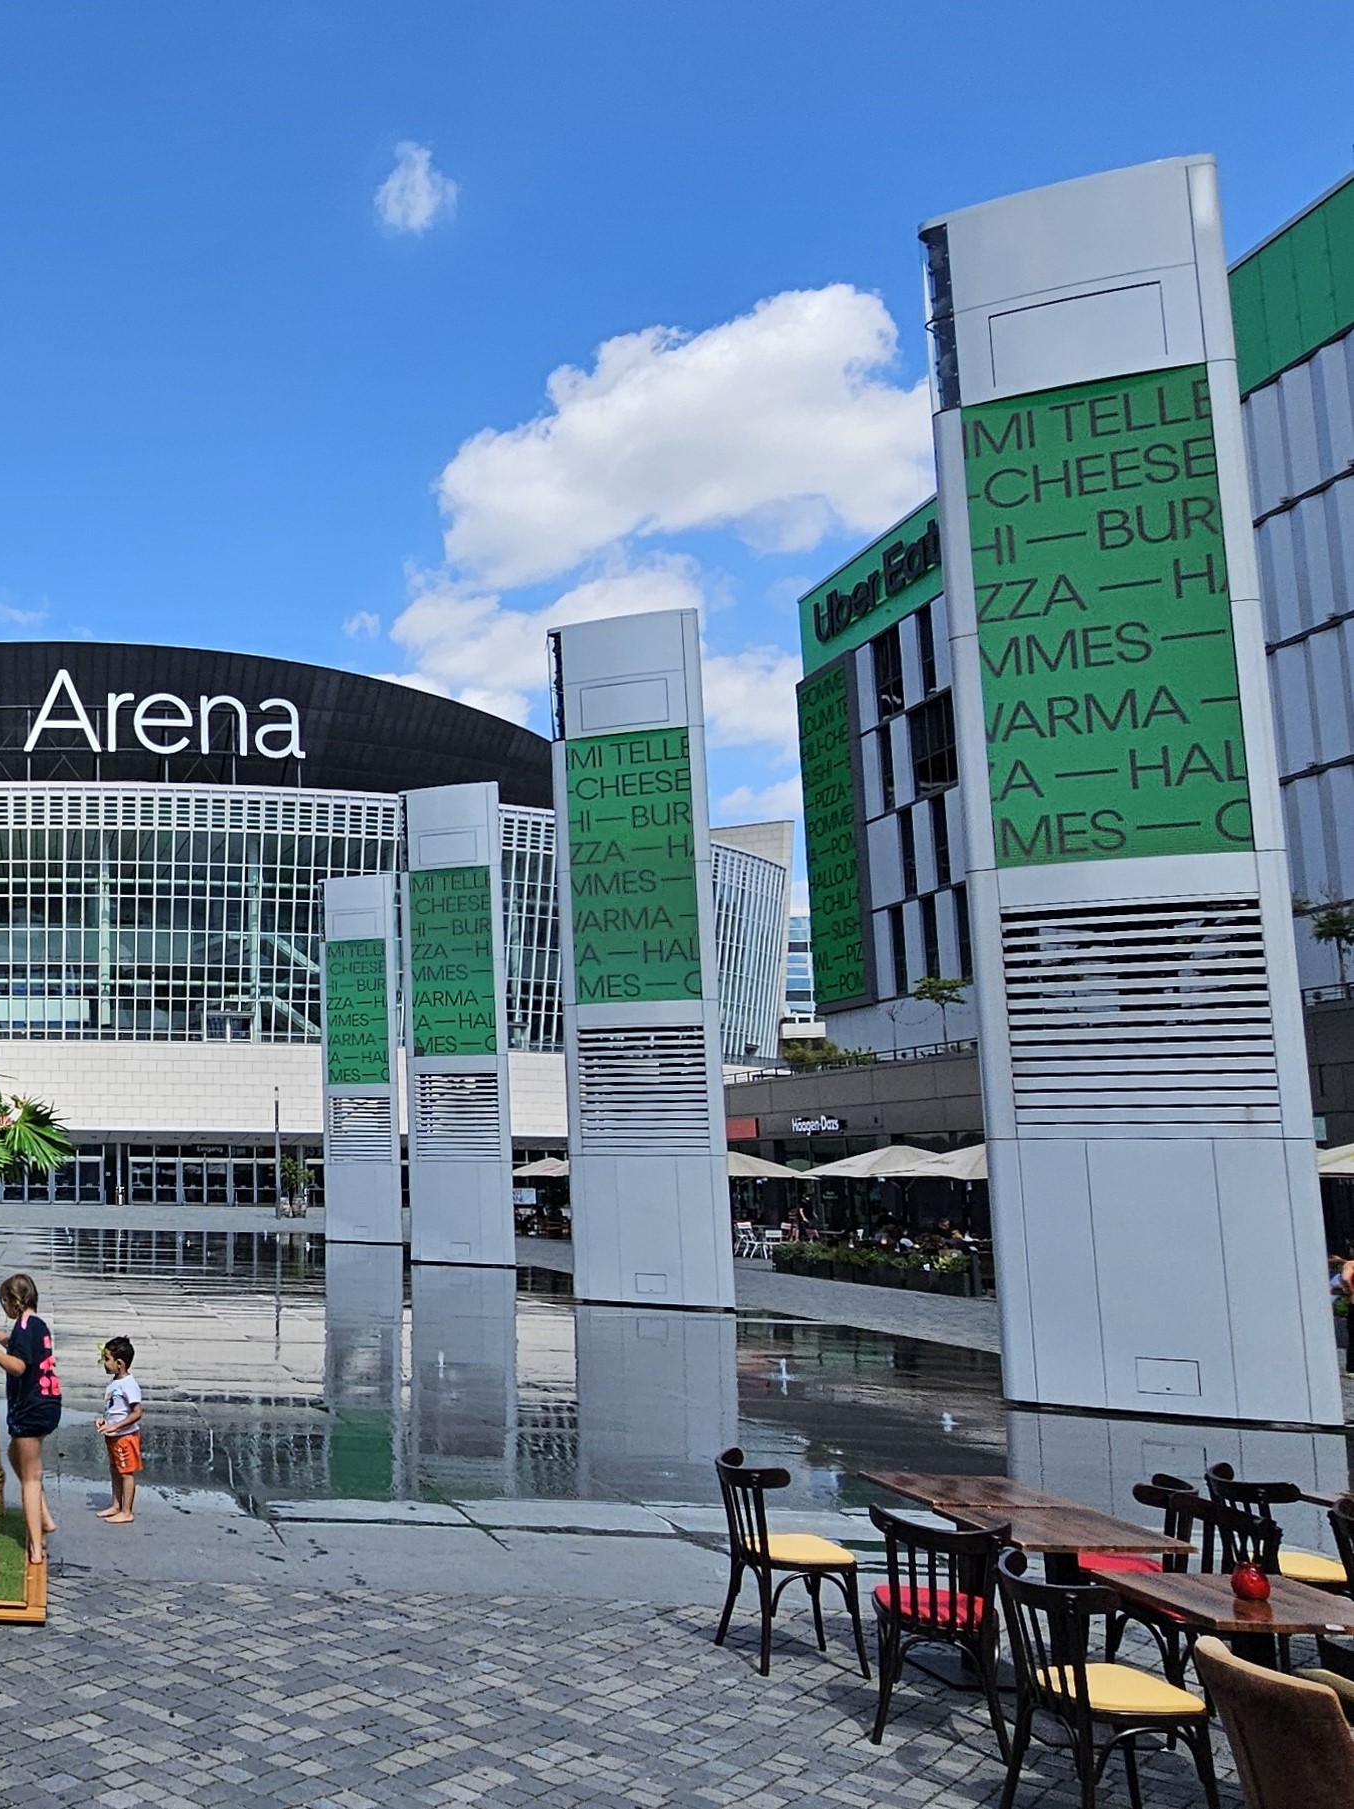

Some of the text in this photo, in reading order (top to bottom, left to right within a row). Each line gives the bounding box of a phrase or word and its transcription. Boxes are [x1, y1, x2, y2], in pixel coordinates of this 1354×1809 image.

[1097, 496, 1220, 551] BUR
[974, 553, 1230, 623] ZZA H
[812, 567, 880, 644] Uber
[23, 669, 306, 759] Arena
[814, 781, 847, 812] PIZZA
[631, 801, 690, 829] BUR
[570, 834, 694, 866] ZZA H
[1000, 809, 1127, 859] MES
[452, 916, 490, 936] BUR
[357, 977, 386, 992] BUR
[579, 974, 641, 999] MES
